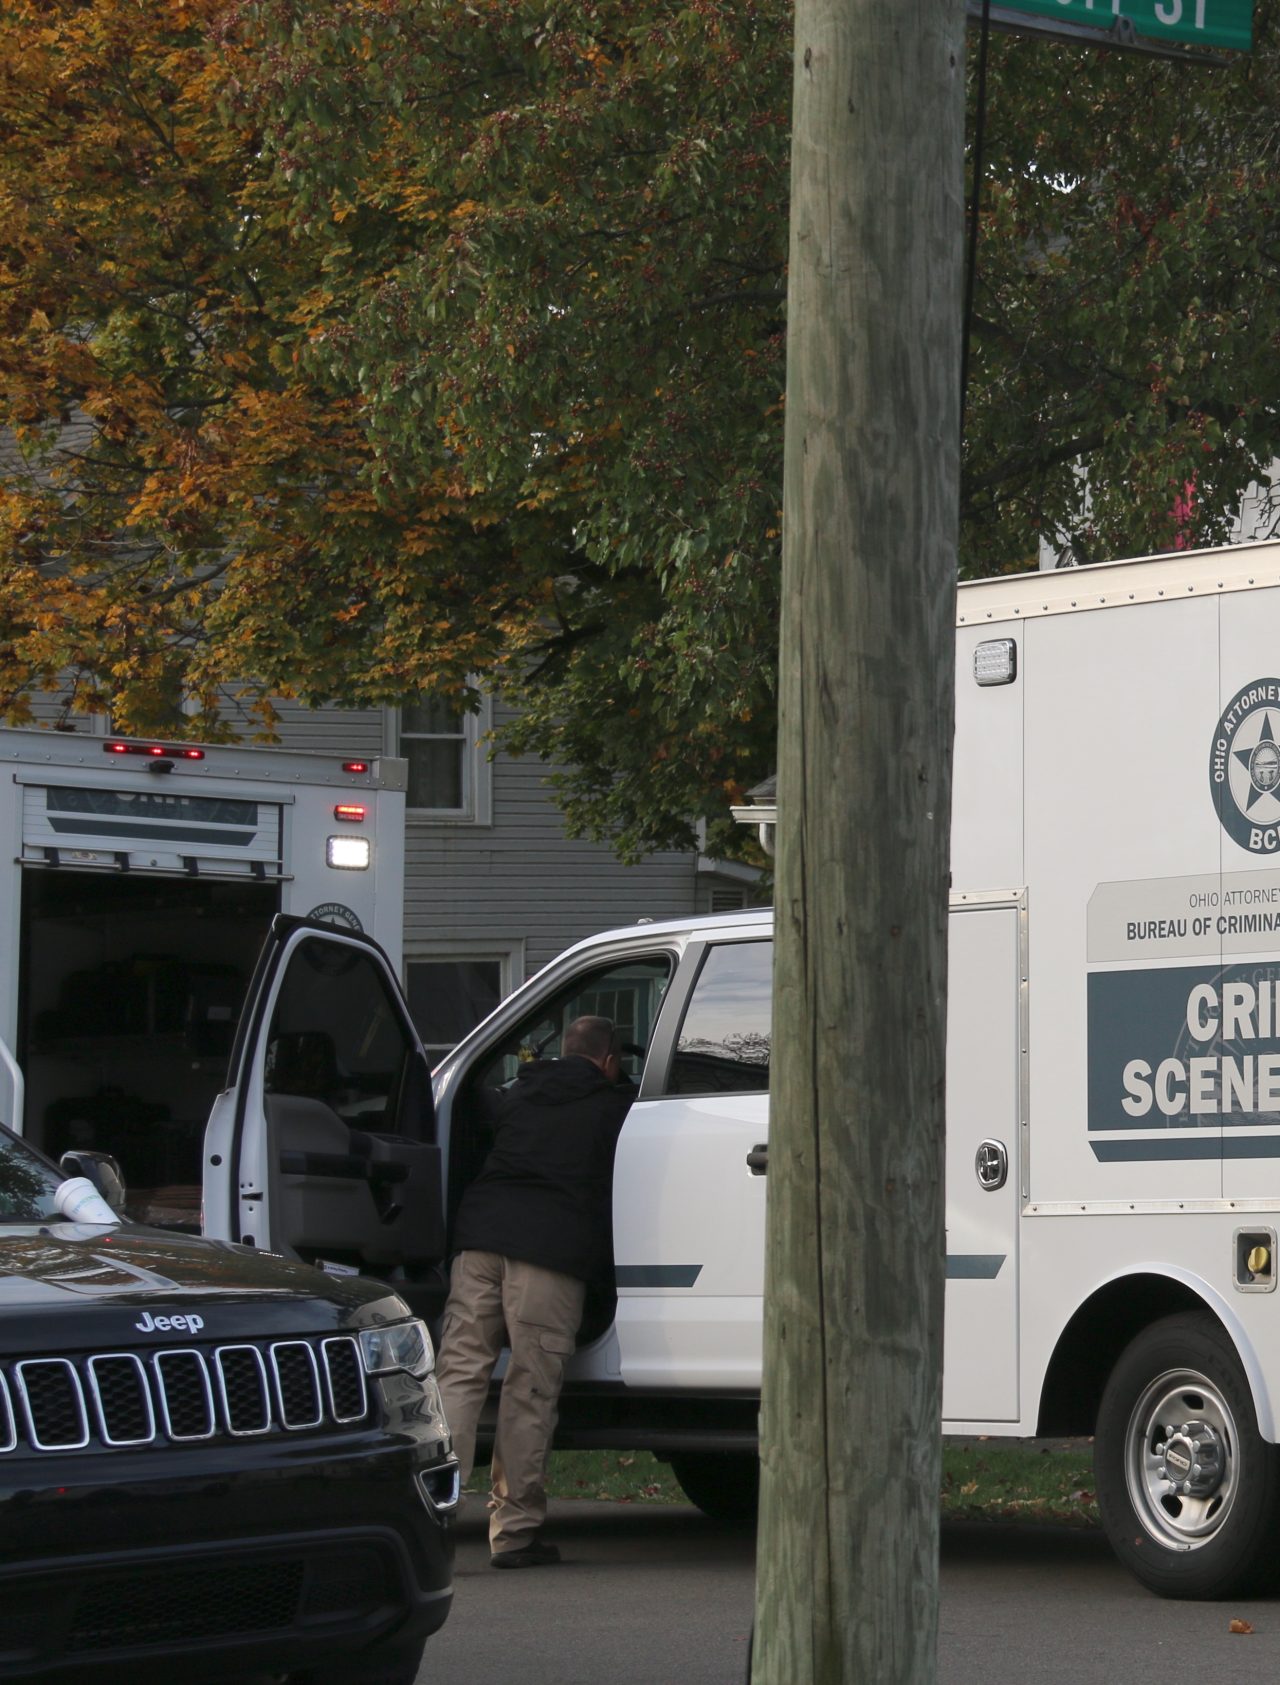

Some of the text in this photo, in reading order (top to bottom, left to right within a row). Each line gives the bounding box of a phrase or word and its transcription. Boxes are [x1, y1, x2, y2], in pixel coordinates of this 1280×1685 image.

[1214, 738, 1228, 783] OHIO
[1189, 892, 1219, 908] OHIO
[310, 905, 344, 920] TTORNEY
[1126, 918, 1187, 941] BUREAU
[1192, 917, 1212, 936] OF
[135, 1311, 204, 1335] Jeep
